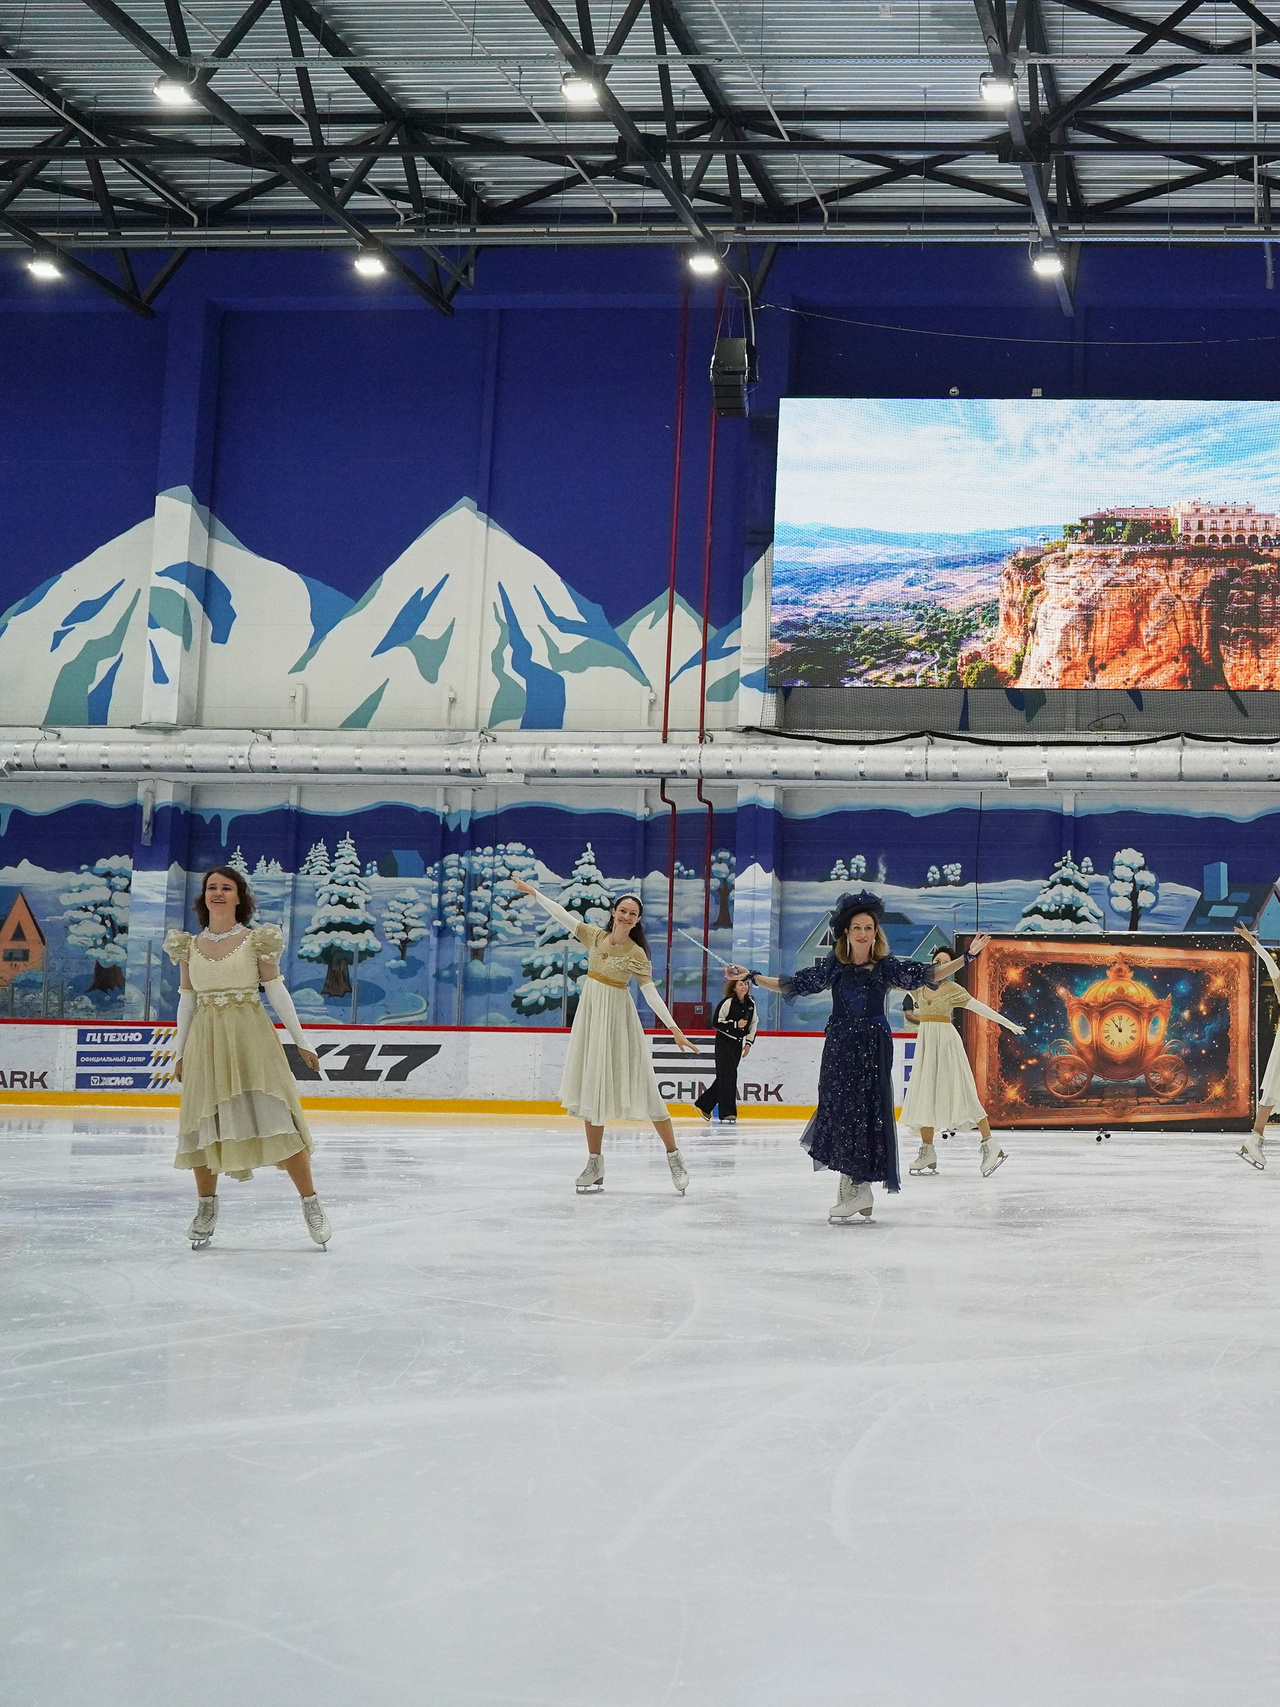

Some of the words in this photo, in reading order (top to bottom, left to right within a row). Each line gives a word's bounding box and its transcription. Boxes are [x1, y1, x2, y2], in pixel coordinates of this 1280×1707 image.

[86, 1032, 101, 1044] ГЦ
[103, 1032, 143, 1042] ТЕХНО
[80, 1055, 126, 1063] ОФИЦИАЛЬНЫЙ
